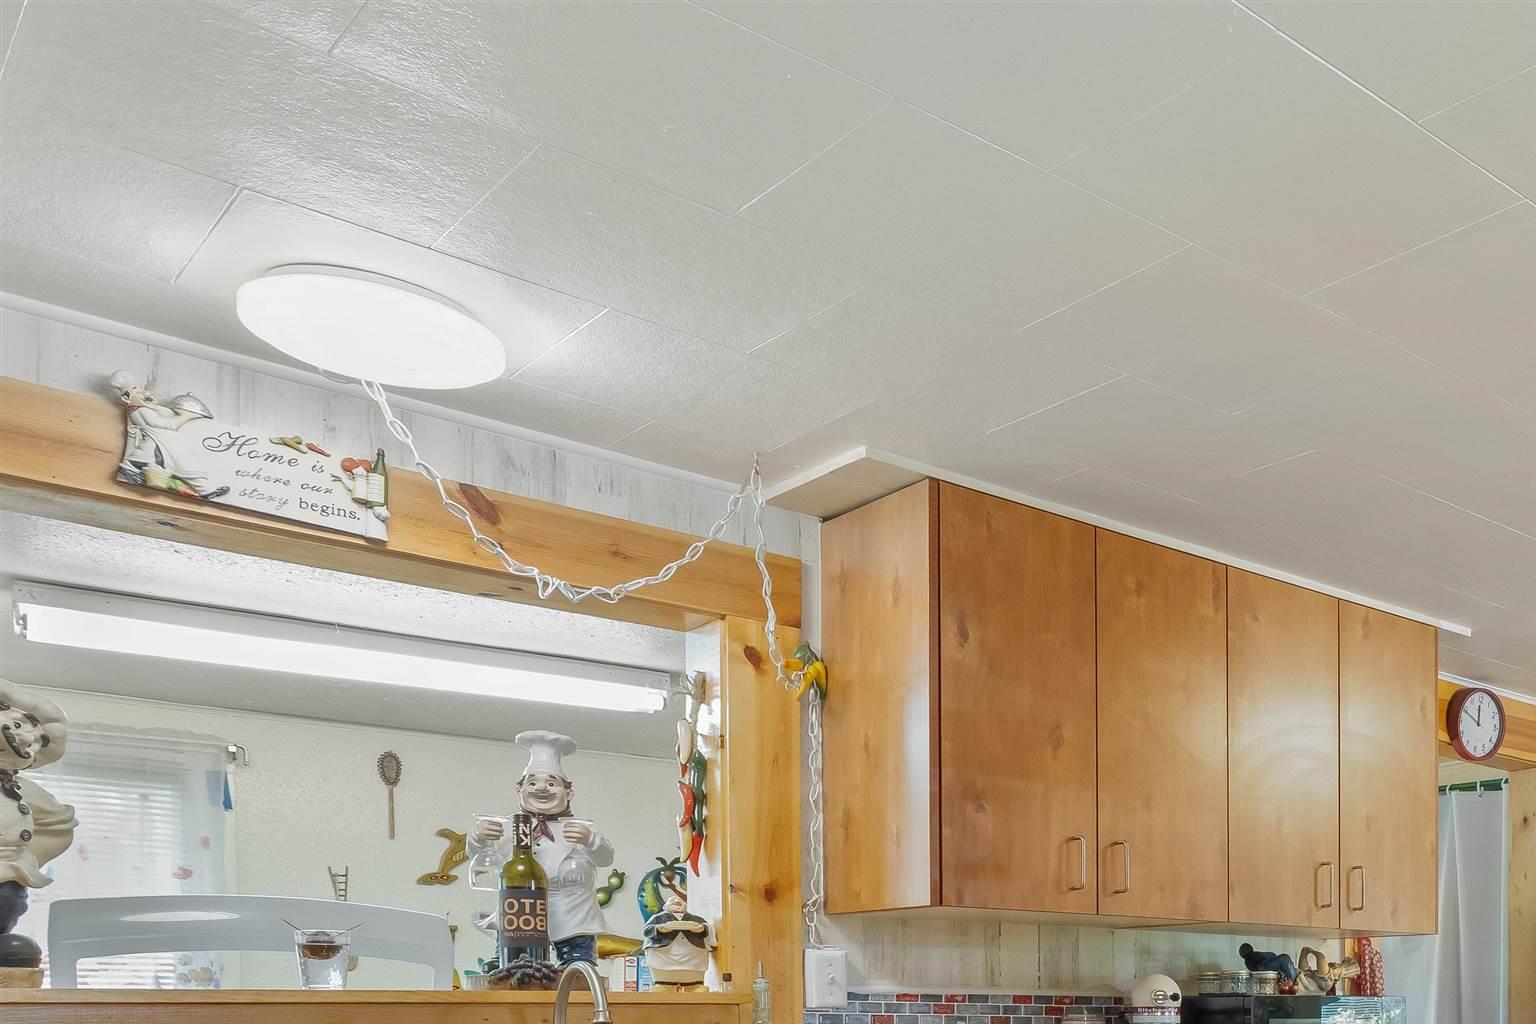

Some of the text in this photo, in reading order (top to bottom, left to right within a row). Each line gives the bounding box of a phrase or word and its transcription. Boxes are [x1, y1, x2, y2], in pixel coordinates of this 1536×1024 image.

[202, 431, 325, 473] Home is
[235, 467, 336, 495] where our
[238, 486, 361, 521] story begins.
